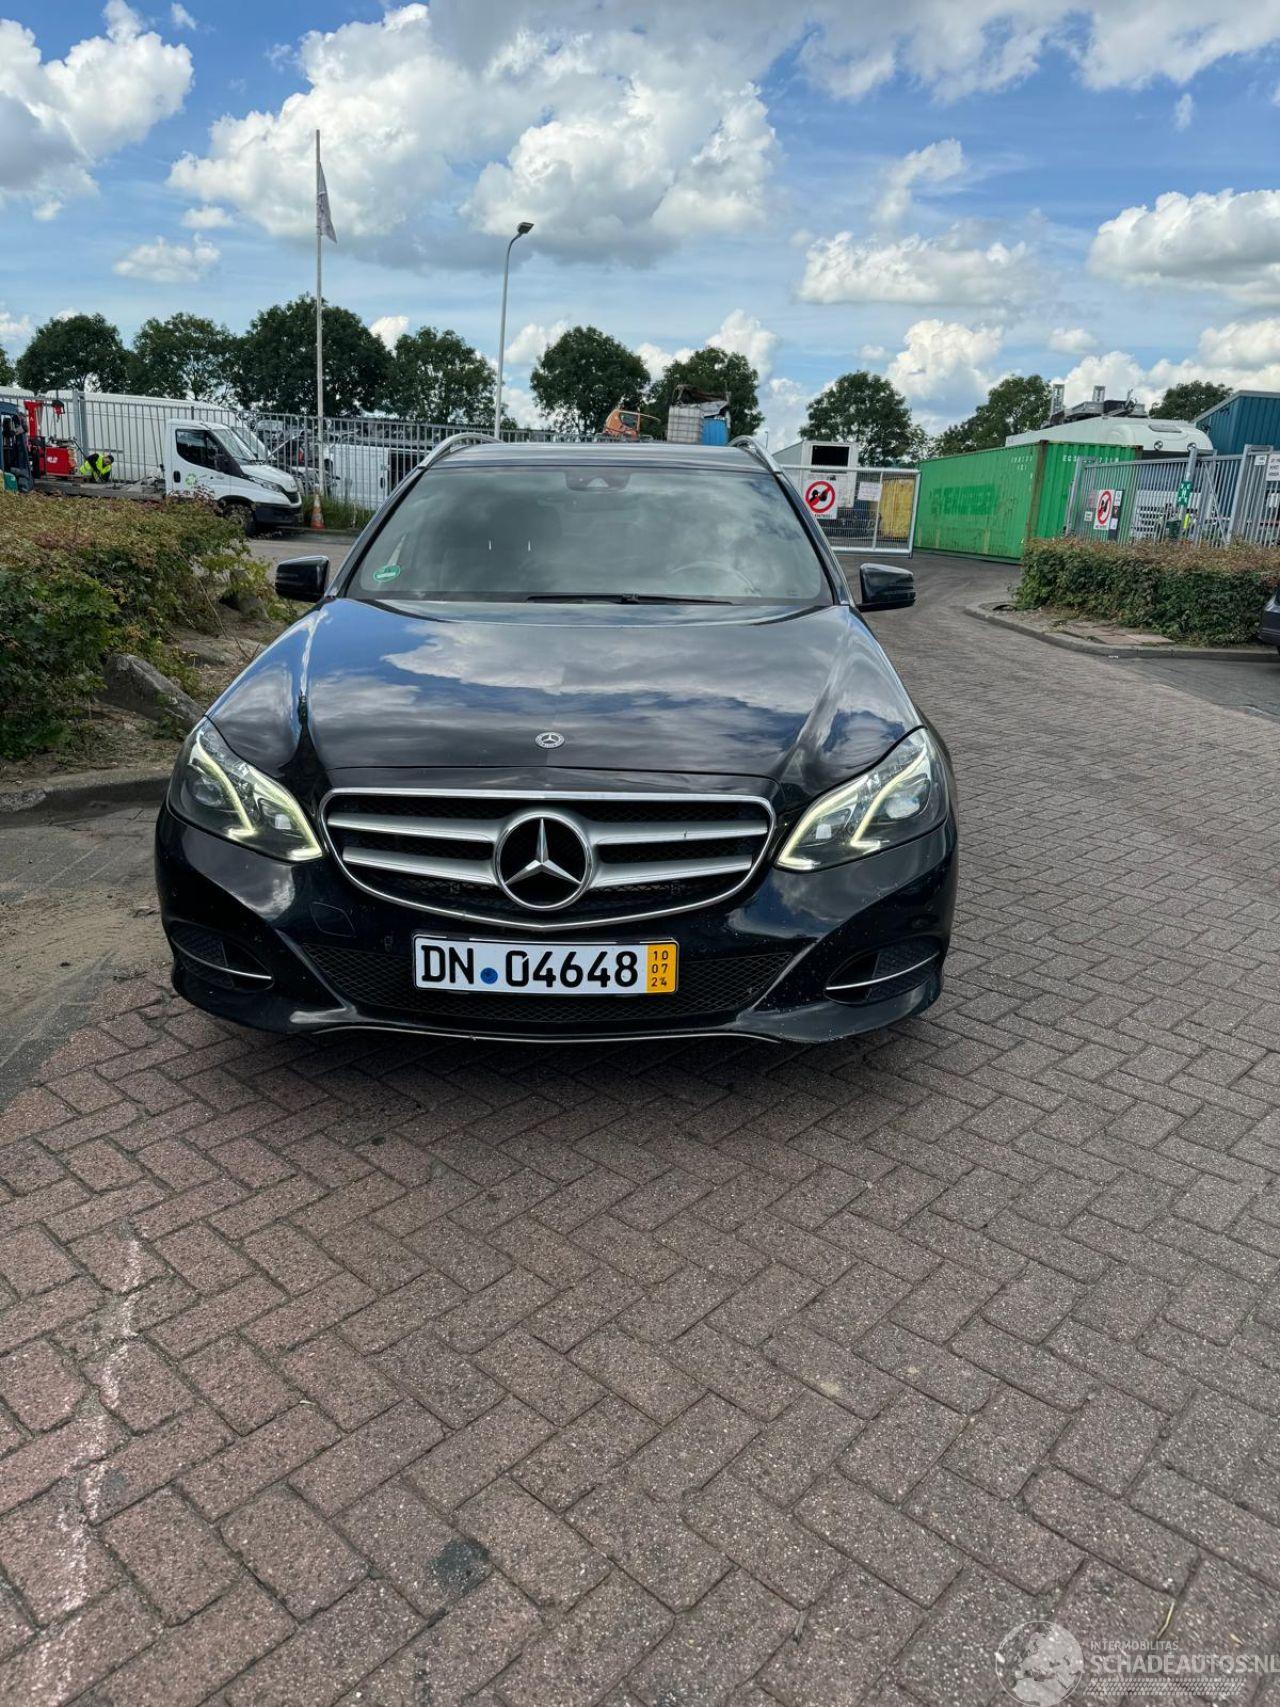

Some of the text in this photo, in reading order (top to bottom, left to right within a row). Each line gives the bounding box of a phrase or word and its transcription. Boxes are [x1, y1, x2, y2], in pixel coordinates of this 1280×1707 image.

[653, 950, 669, 961] 10
[421, 944, 638, 988] DN 04648
[651, 963, 668, 974] 07
[651, 976, 667, 987] 24
